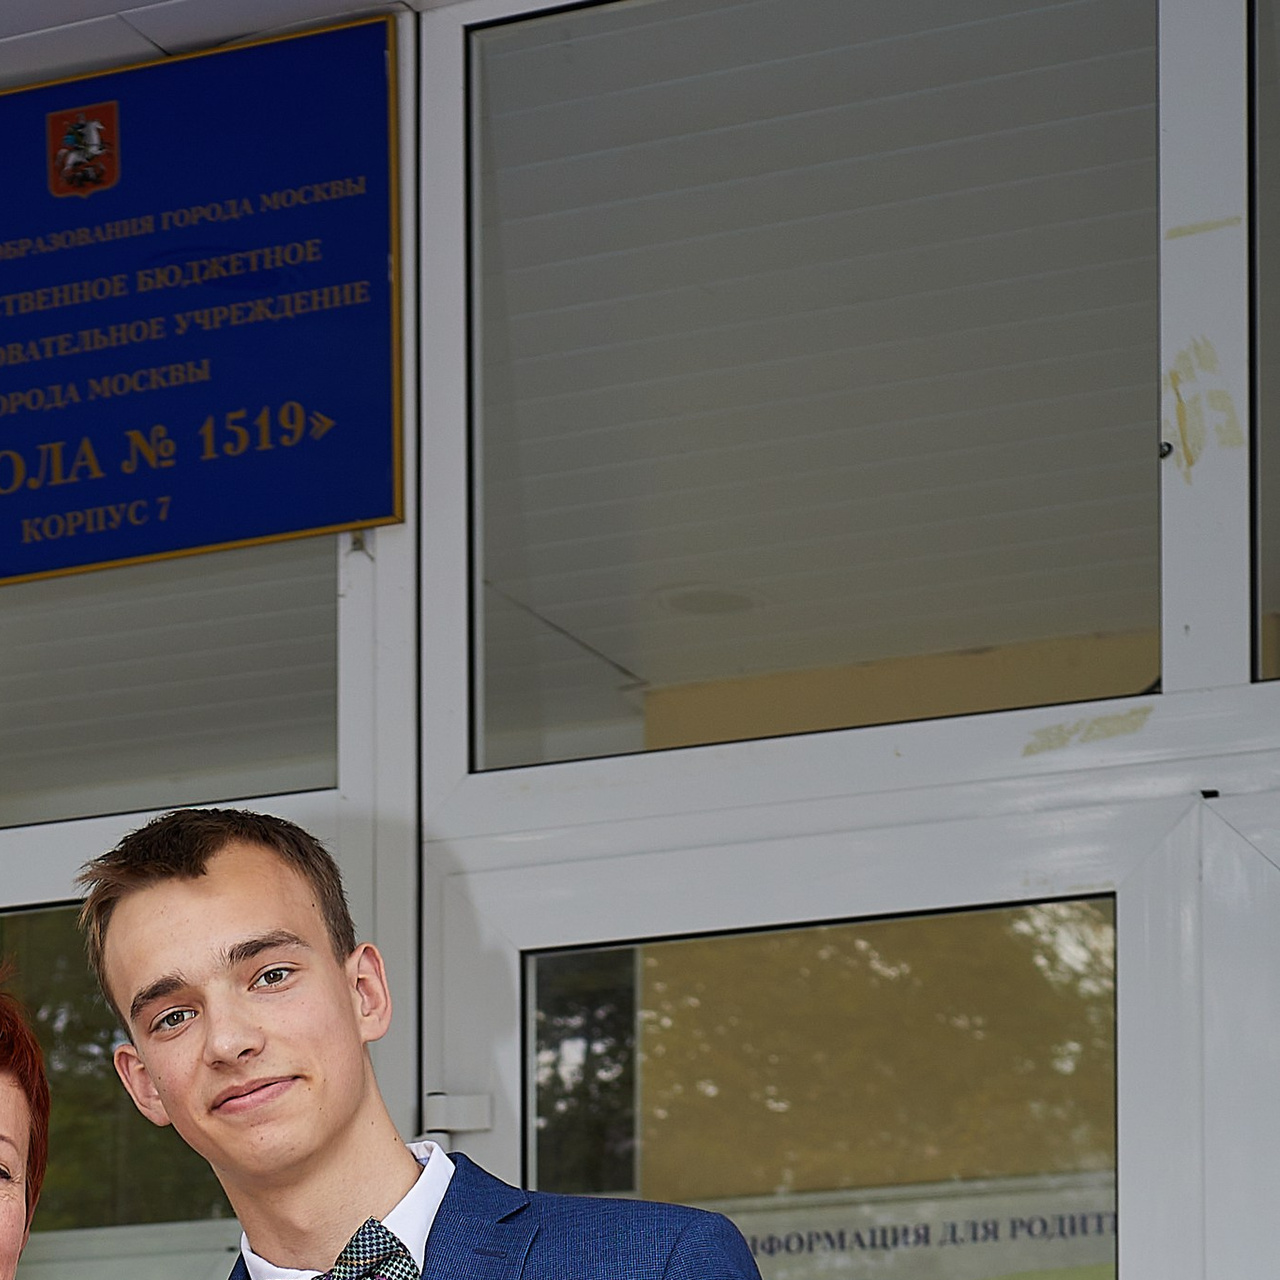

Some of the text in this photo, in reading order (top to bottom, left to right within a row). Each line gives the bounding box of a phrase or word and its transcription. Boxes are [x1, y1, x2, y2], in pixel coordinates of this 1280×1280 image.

[160, 197, 254, 231] ГОРОДА
[260, 175, 366, 212] МОСКВЫ
[136, 239, 323, 294] БЮДЖЕТНОЕ
[175, 281, 371, 337] УЧРЕЖДЕНИЕ
[87, 358, 212, 404] МОСКВЫ
[121, 424, 177, 475] №
[198, 400, 337, 462] 1519»
[21, 496, 171, 544] КОРПУС 7
[938, 1218, 999, 1247] ДЛЯ
